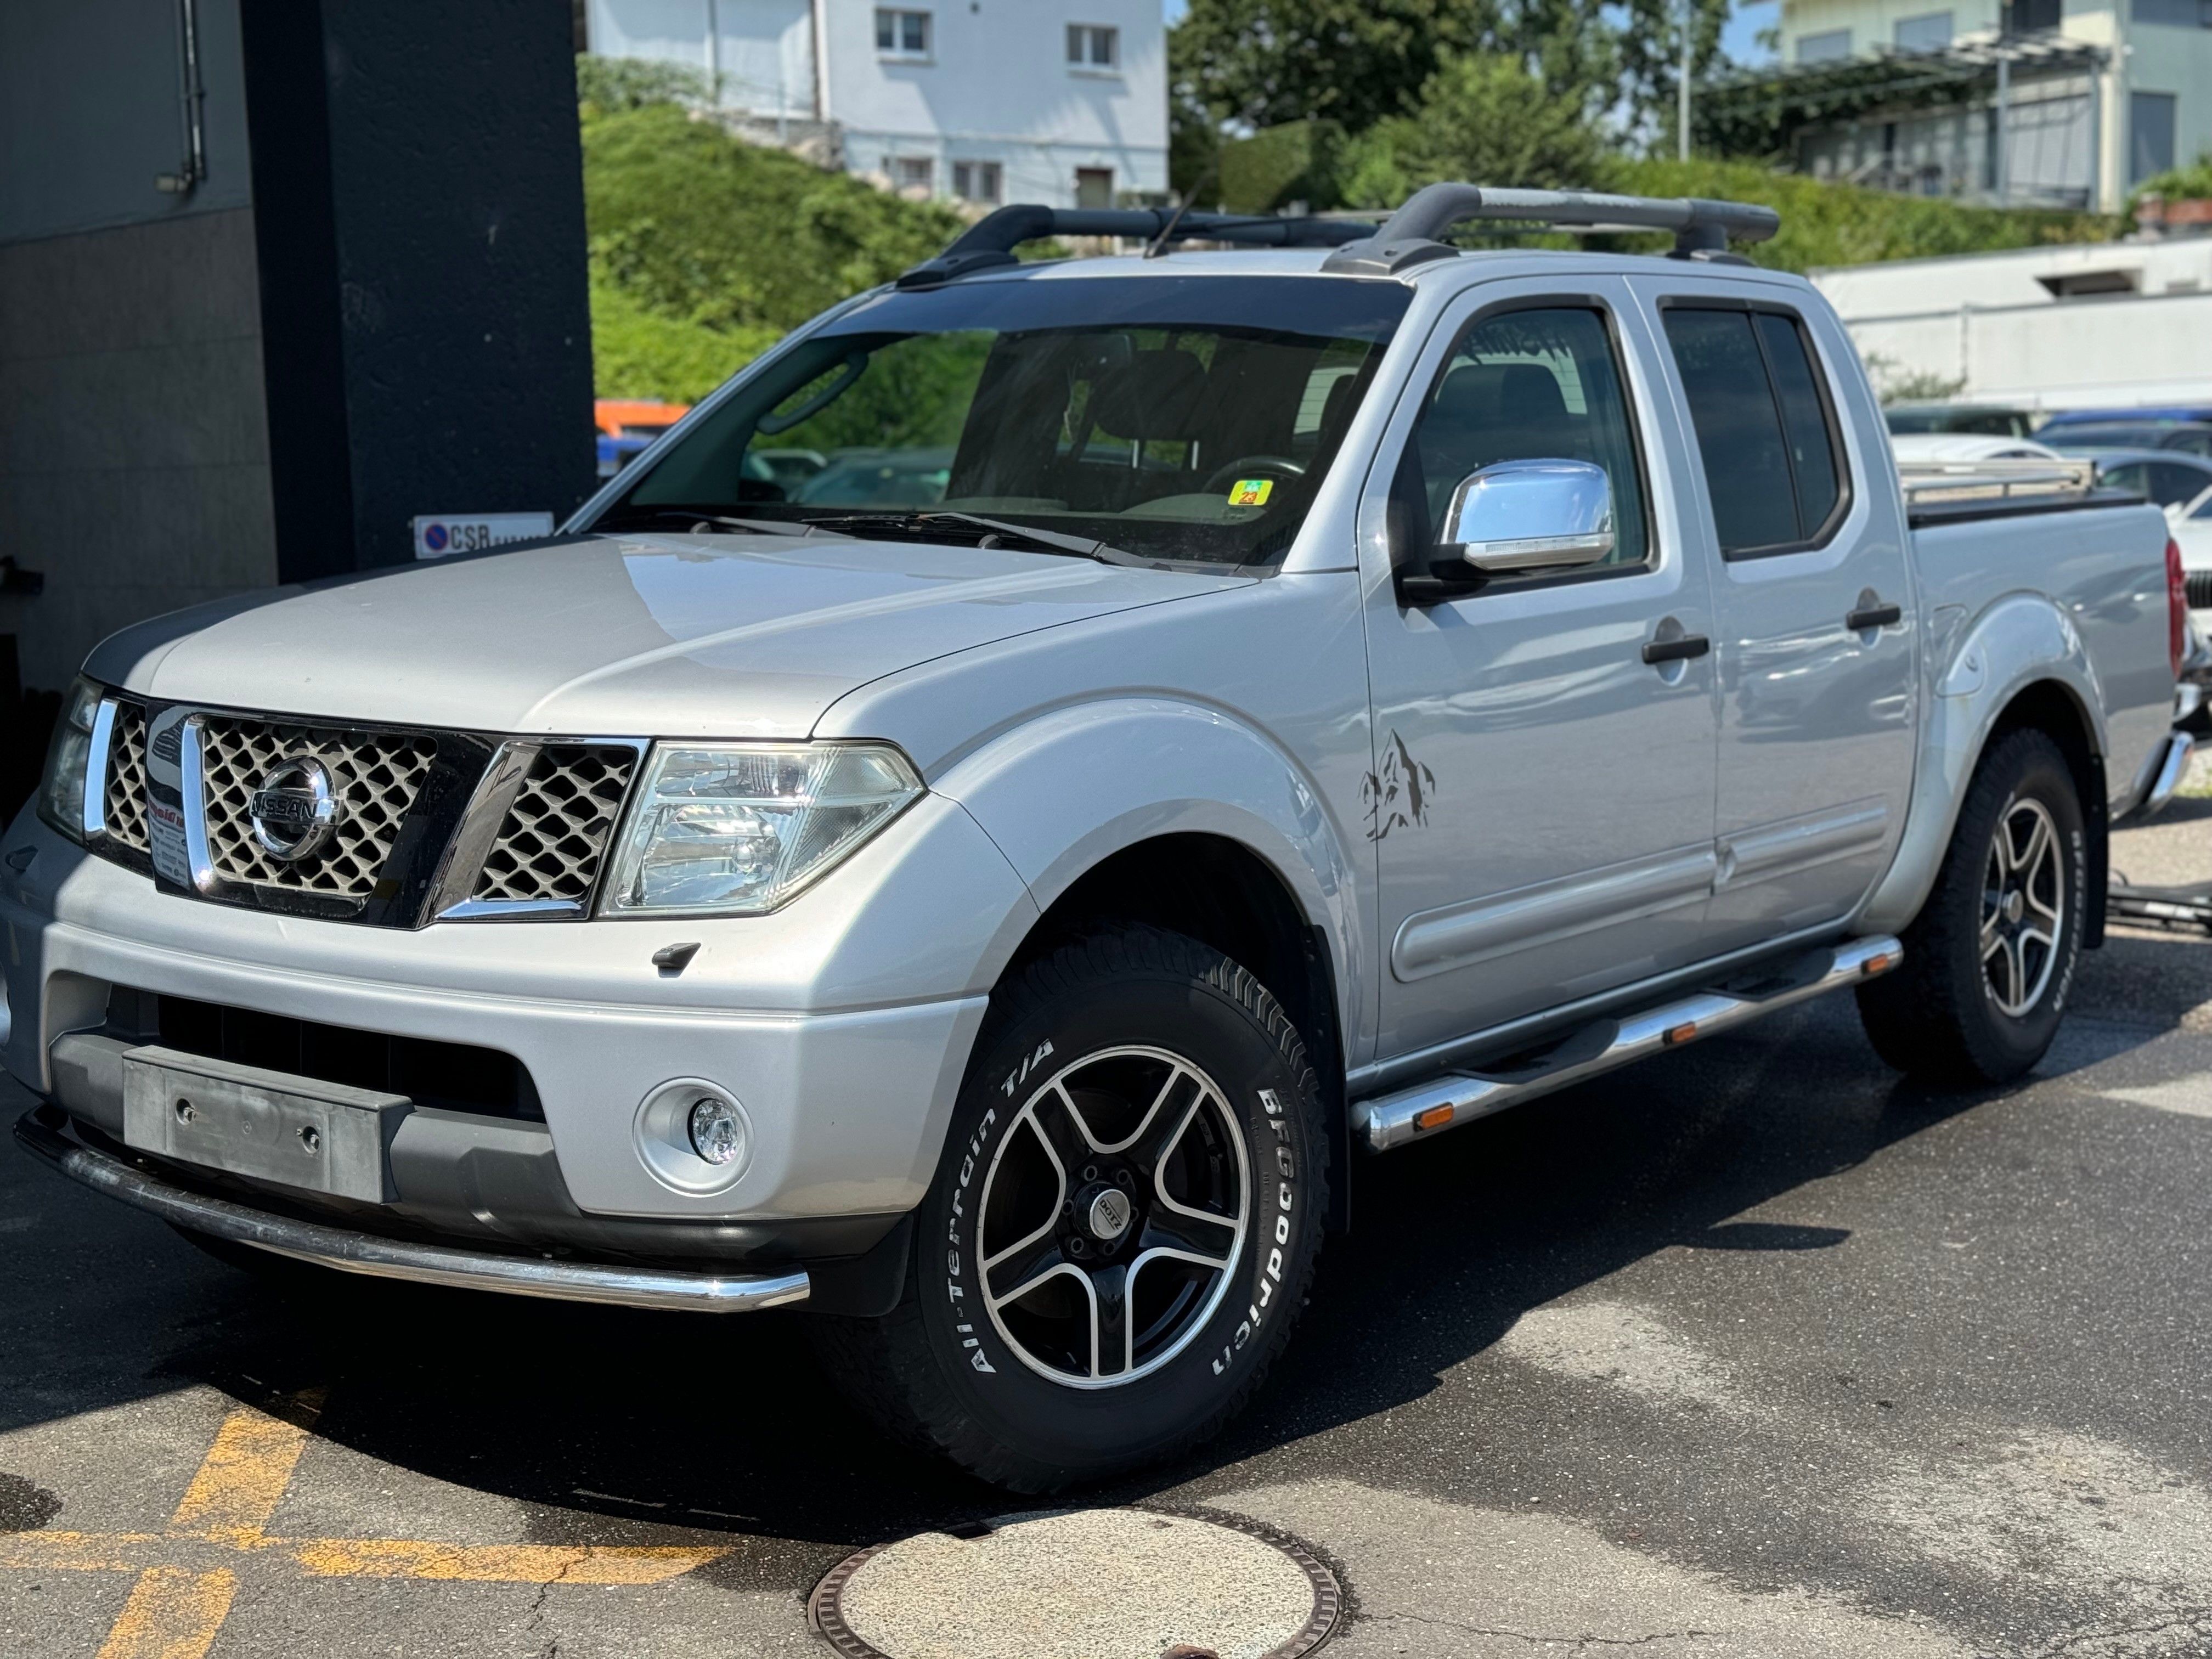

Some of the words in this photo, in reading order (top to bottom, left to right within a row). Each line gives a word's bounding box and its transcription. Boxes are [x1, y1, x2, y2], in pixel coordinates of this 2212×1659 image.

[1239, 492, 1258, 502] 23
[450, 524, 489, 550] CSR
[1001, 1038, 1054, 1097] T/A
[1099, 1199, 1122, 1230] DOTZ
[1212, 1088, 1295, 1375] BFGoodrich
